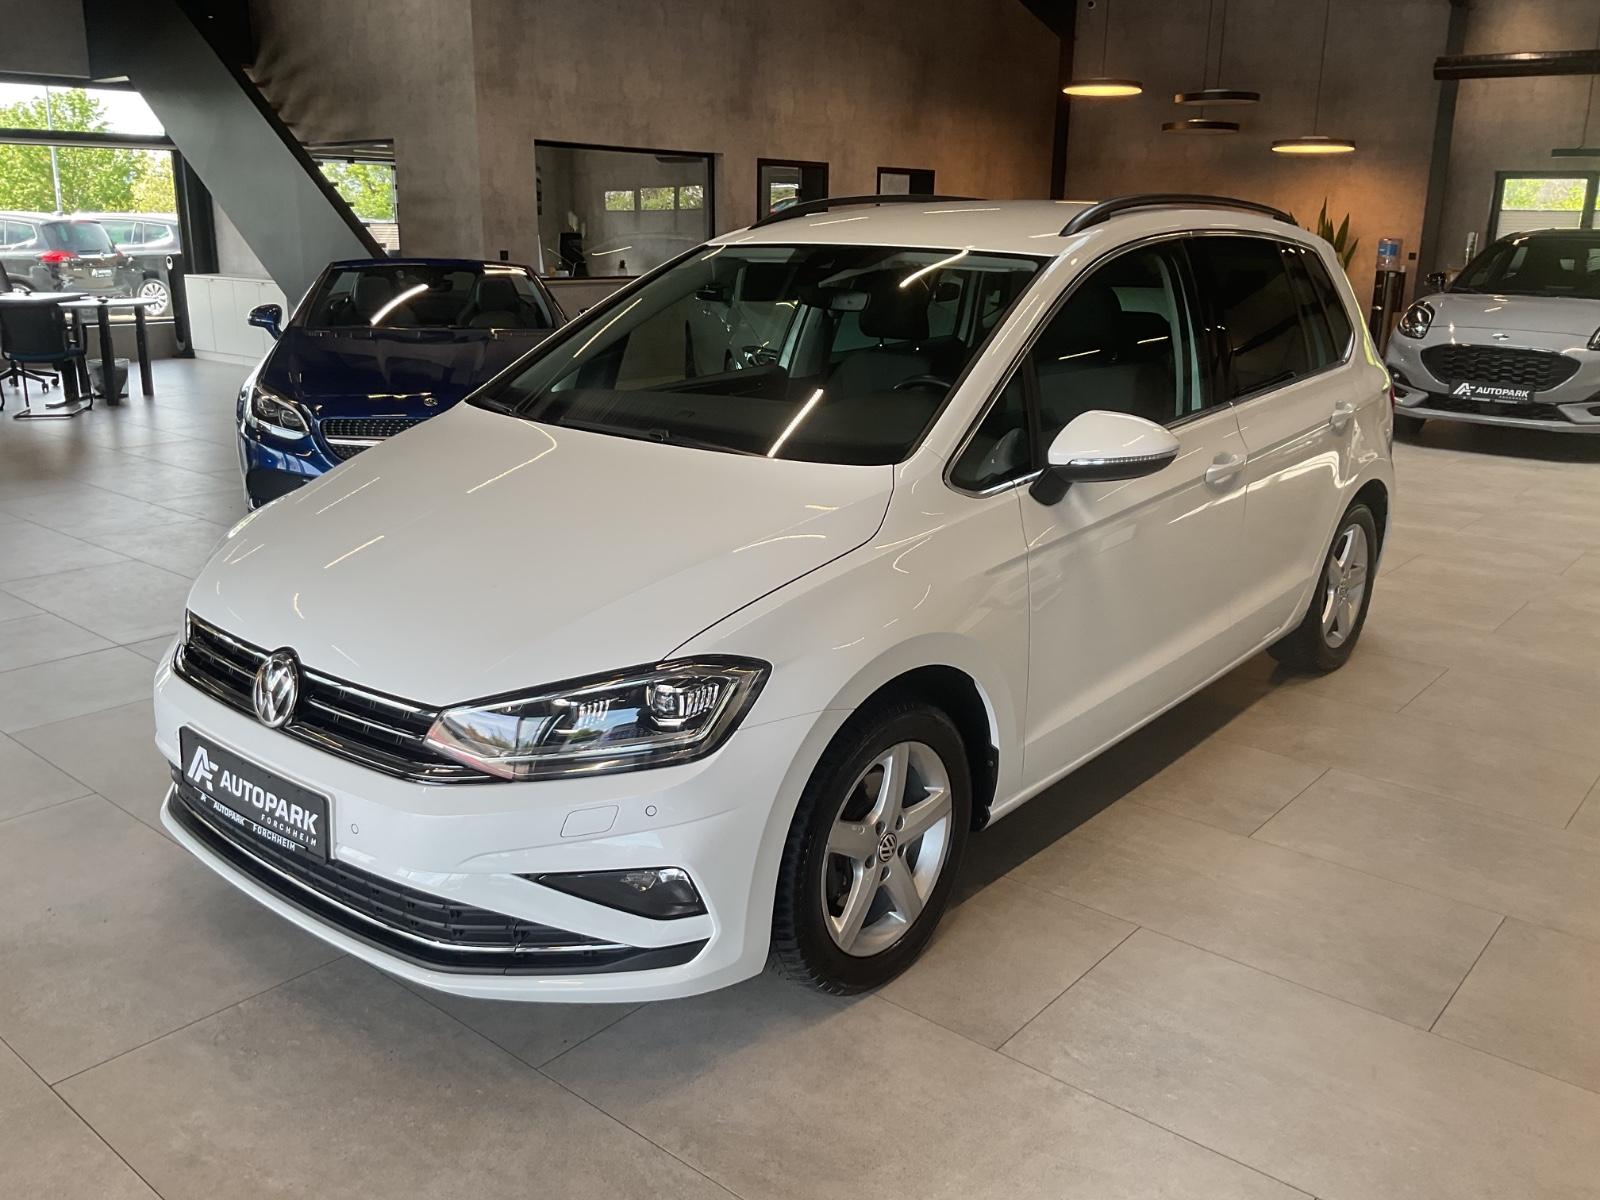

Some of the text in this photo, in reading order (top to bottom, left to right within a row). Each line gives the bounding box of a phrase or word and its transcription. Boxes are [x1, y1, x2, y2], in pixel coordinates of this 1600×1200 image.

[1475, 387, 1530, 398] AUTOPARK
[220, 769, 319, 835] AUTOPARK
[213, 800, 296, 851] AUTOPARK FORCHHEIM
[261, 813, 317, 847] FORCHHEIM
